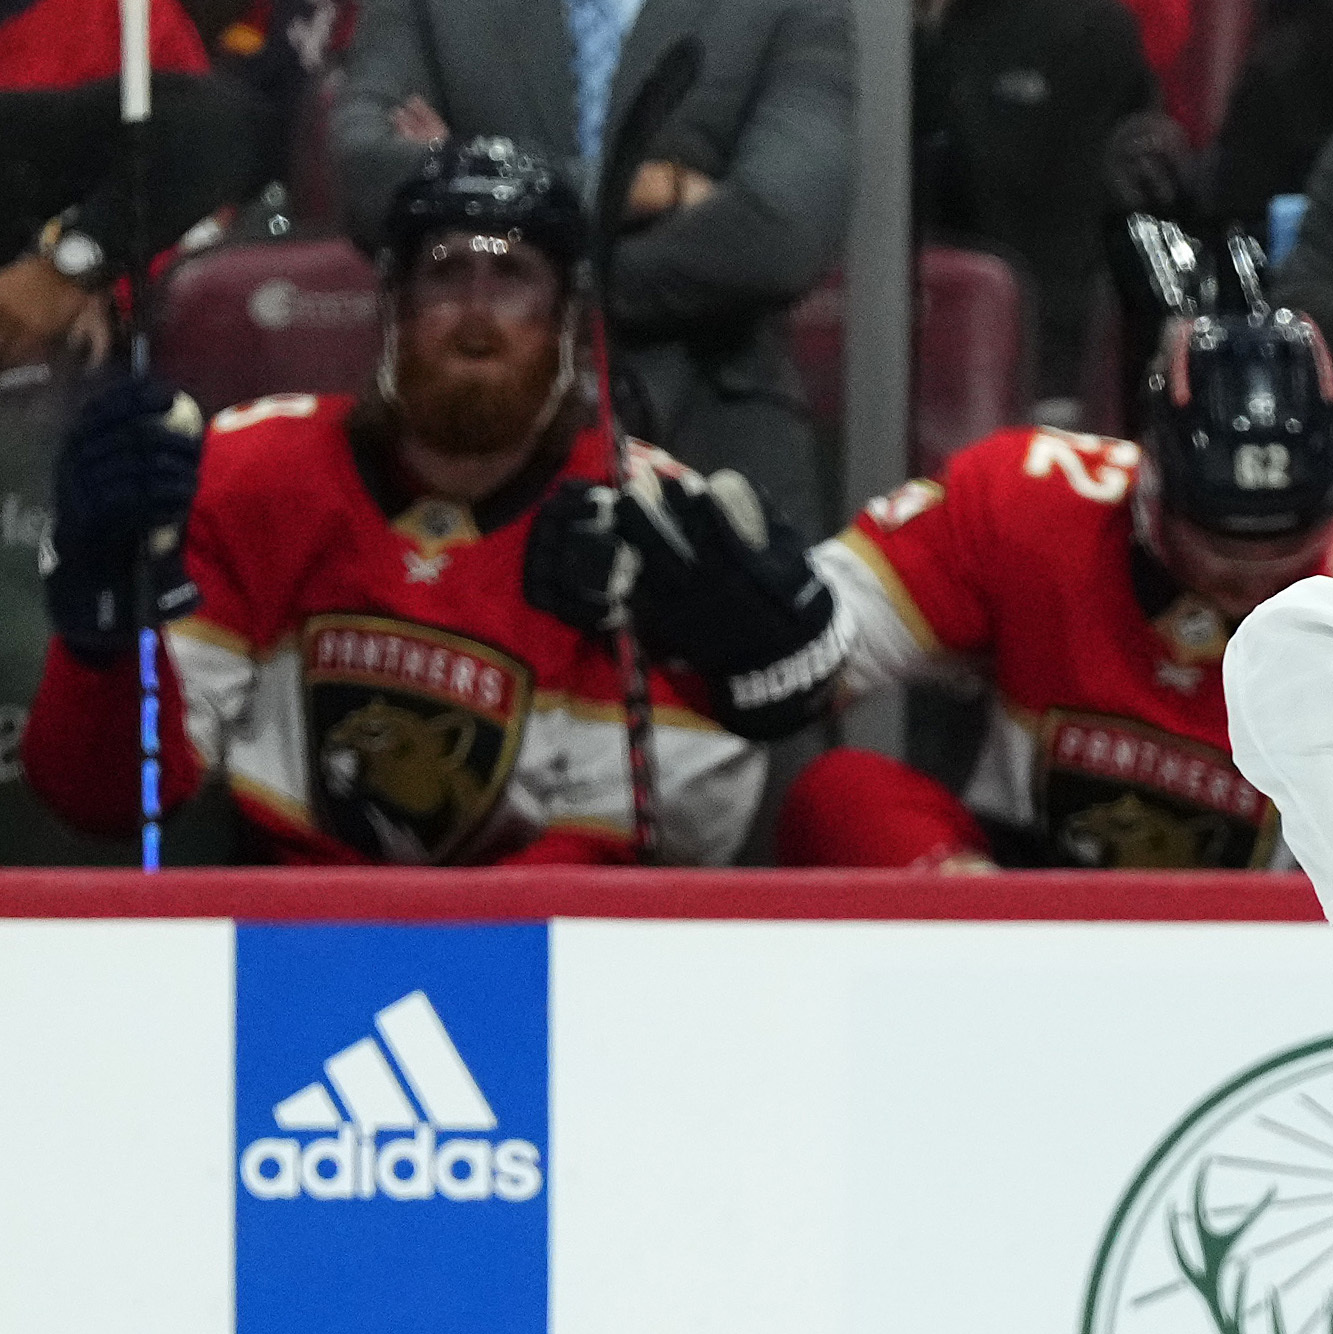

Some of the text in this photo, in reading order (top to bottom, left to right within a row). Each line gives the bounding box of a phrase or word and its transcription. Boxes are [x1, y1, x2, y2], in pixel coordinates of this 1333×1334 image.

[316, 629, 504, 708] PANTHERS
[1057, 726, 1261, 814] PANTHERS
[240, 1121, 543, 1201] adidas
